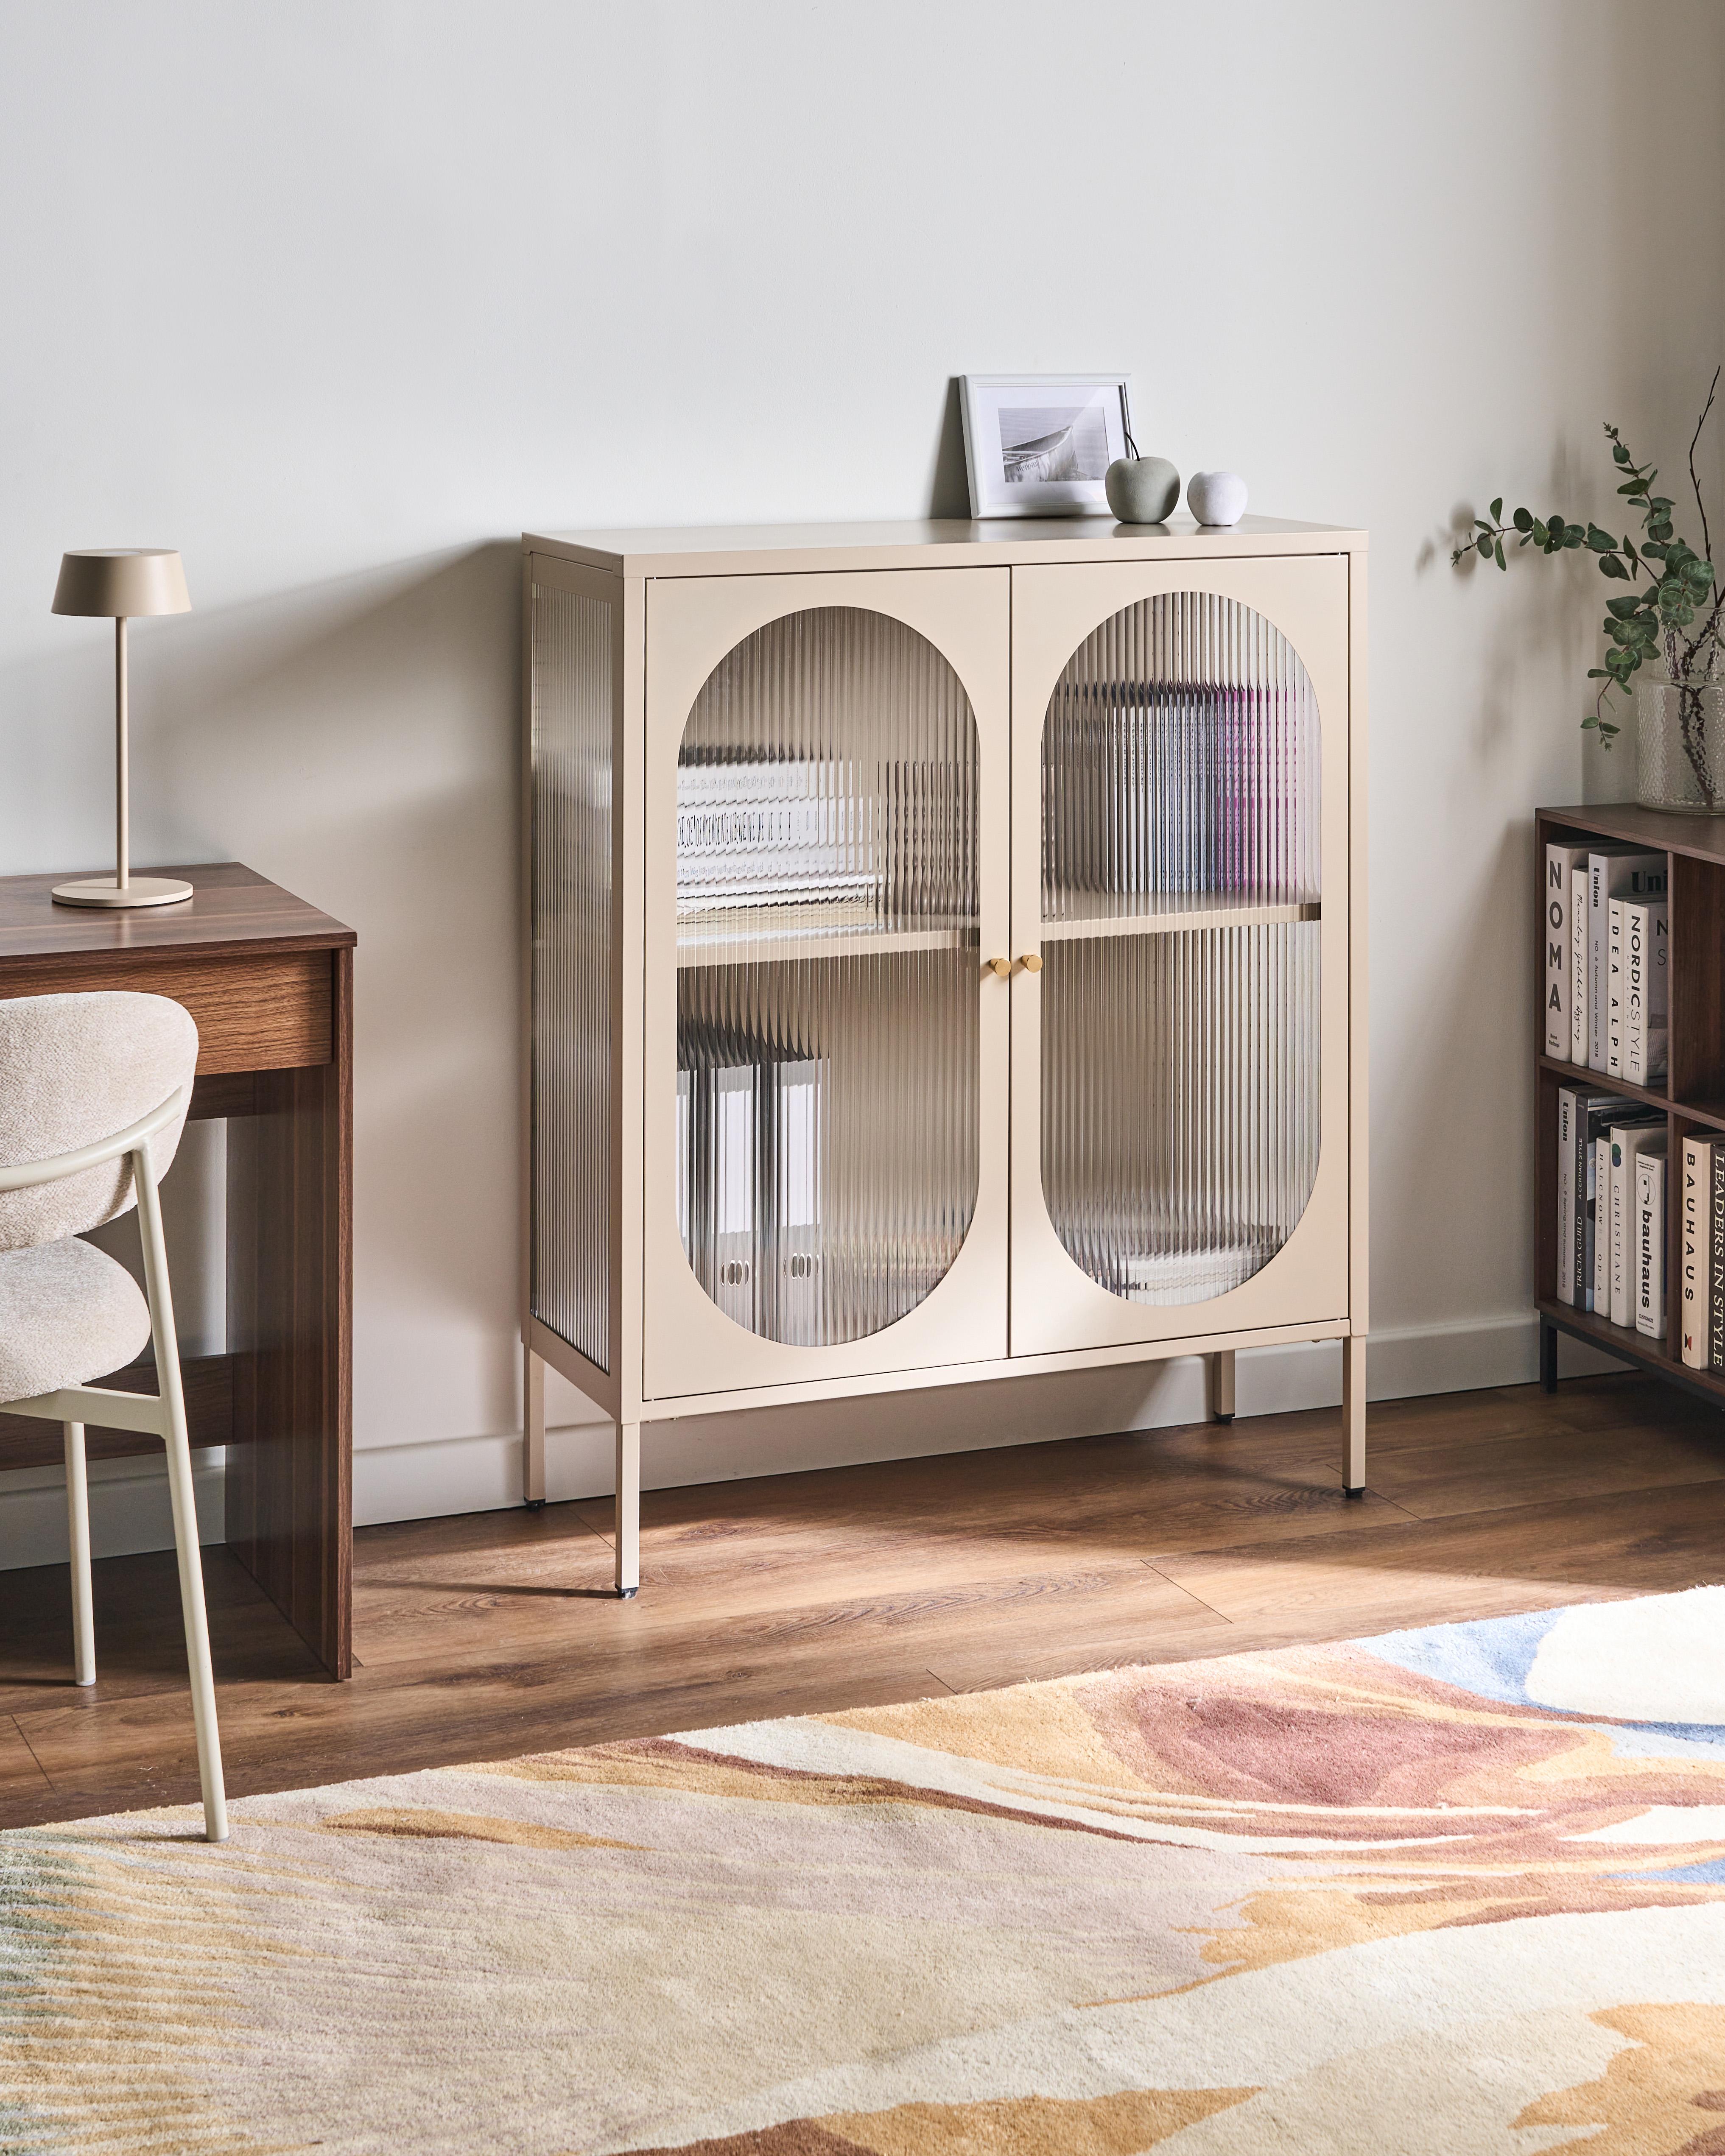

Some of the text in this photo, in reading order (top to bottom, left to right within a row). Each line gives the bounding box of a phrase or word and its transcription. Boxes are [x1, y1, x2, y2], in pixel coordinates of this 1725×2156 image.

[1549, 860, 1563, 1012] NOMA
[1642, 1209, 1652, 1308] bauhaus
[1685, 1153, 1695, 1301] BAUHAUS
[1714, 1153, 1725, 1366] LEADERS IN STYLE
